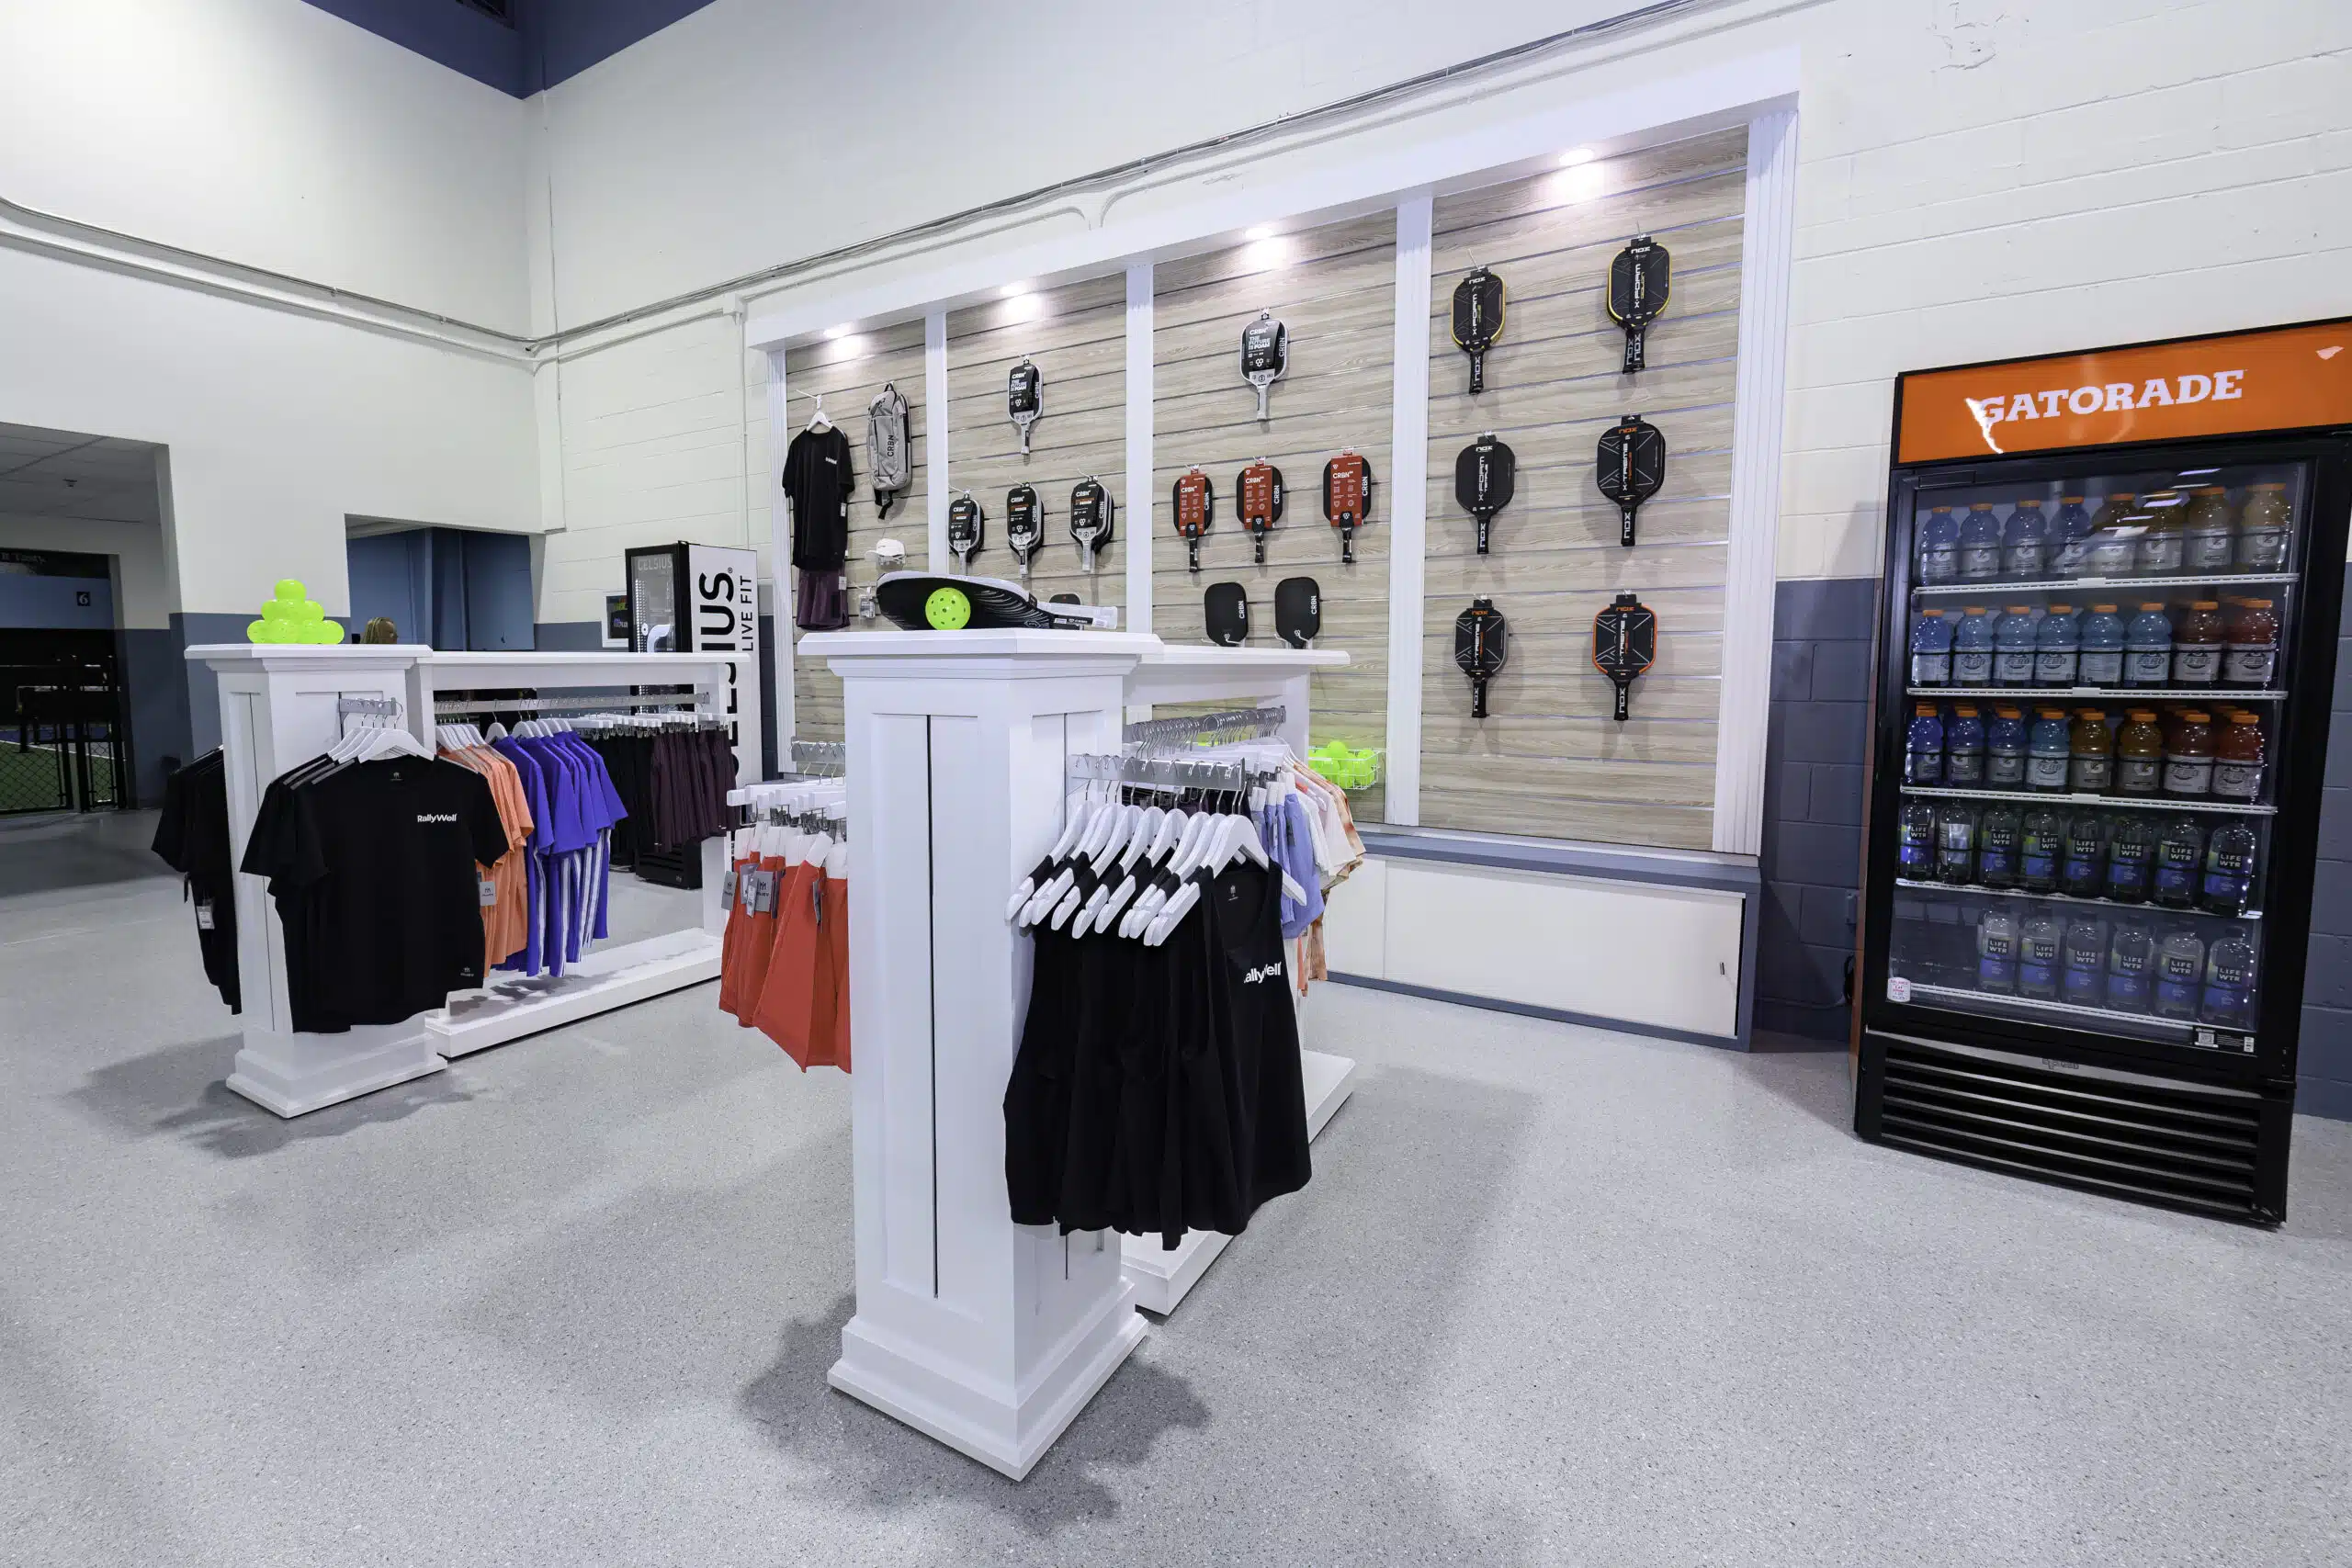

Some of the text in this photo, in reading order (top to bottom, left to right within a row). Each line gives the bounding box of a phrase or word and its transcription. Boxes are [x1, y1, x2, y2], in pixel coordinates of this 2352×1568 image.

[1979, 369, 2245, 423] GATORADE
[79, 593, 88, 604] 6
[741, 575, 753, 651] LIVE FIT
[1244, 961, 1282, 983] allyell
